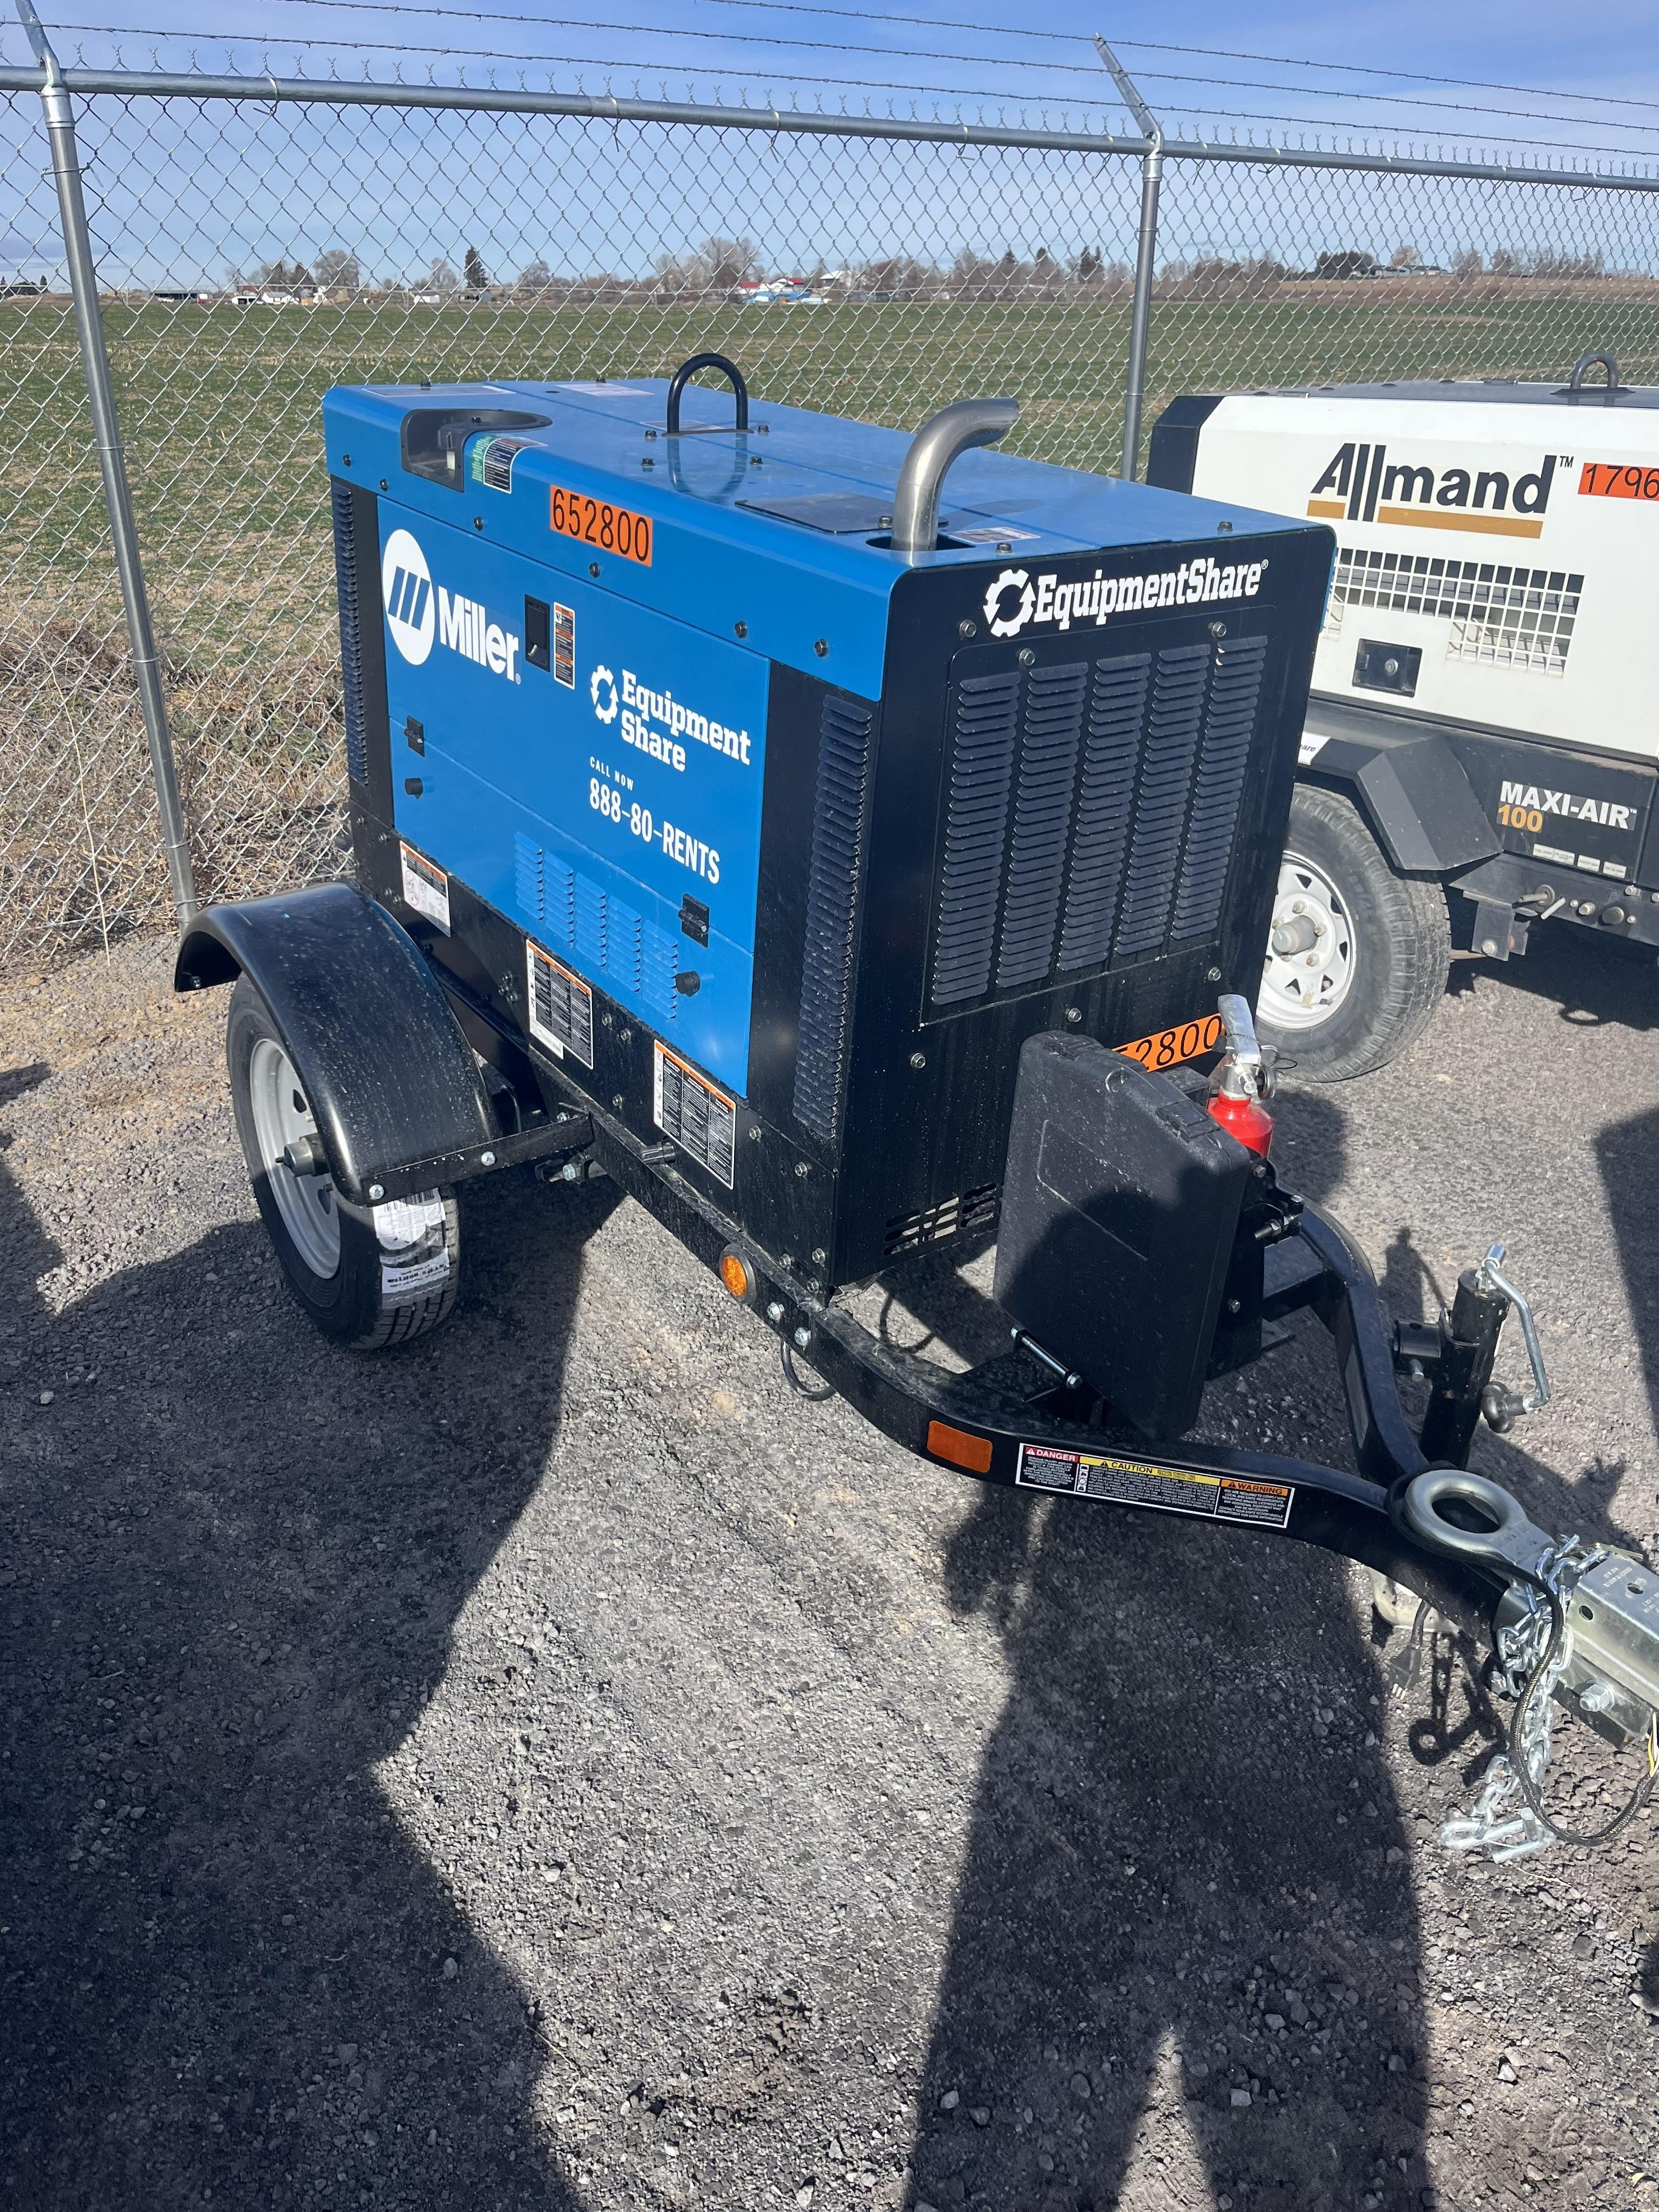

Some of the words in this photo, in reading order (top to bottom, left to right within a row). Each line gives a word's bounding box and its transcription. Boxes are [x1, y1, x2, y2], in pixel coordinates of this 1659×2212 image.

[1310, 442, 1558, 522] Allmand
[1585, 464, 1659, 499] 1796
[553, 489, 649, 562] 652800
[620, 709, 686, 772] Share
[622, 669, 751, 766] Equipment
[589, 756, 611, 778] CALL
[614, 770, 634, 791] NOW
[1498, 804, 1543, 833] 100
[1500, 780, 1630, 830] MAXI-AIR
[589, 777, 720, 884] 888-80-RENTS
[1116, 1015, 1222, 1067] 2800
[1036, 1449, 1076, 1462] DANGER
[1111, 1462, 1153, 1474] CAUTION
[1238, 1483, 1283, 1495] WARNING
